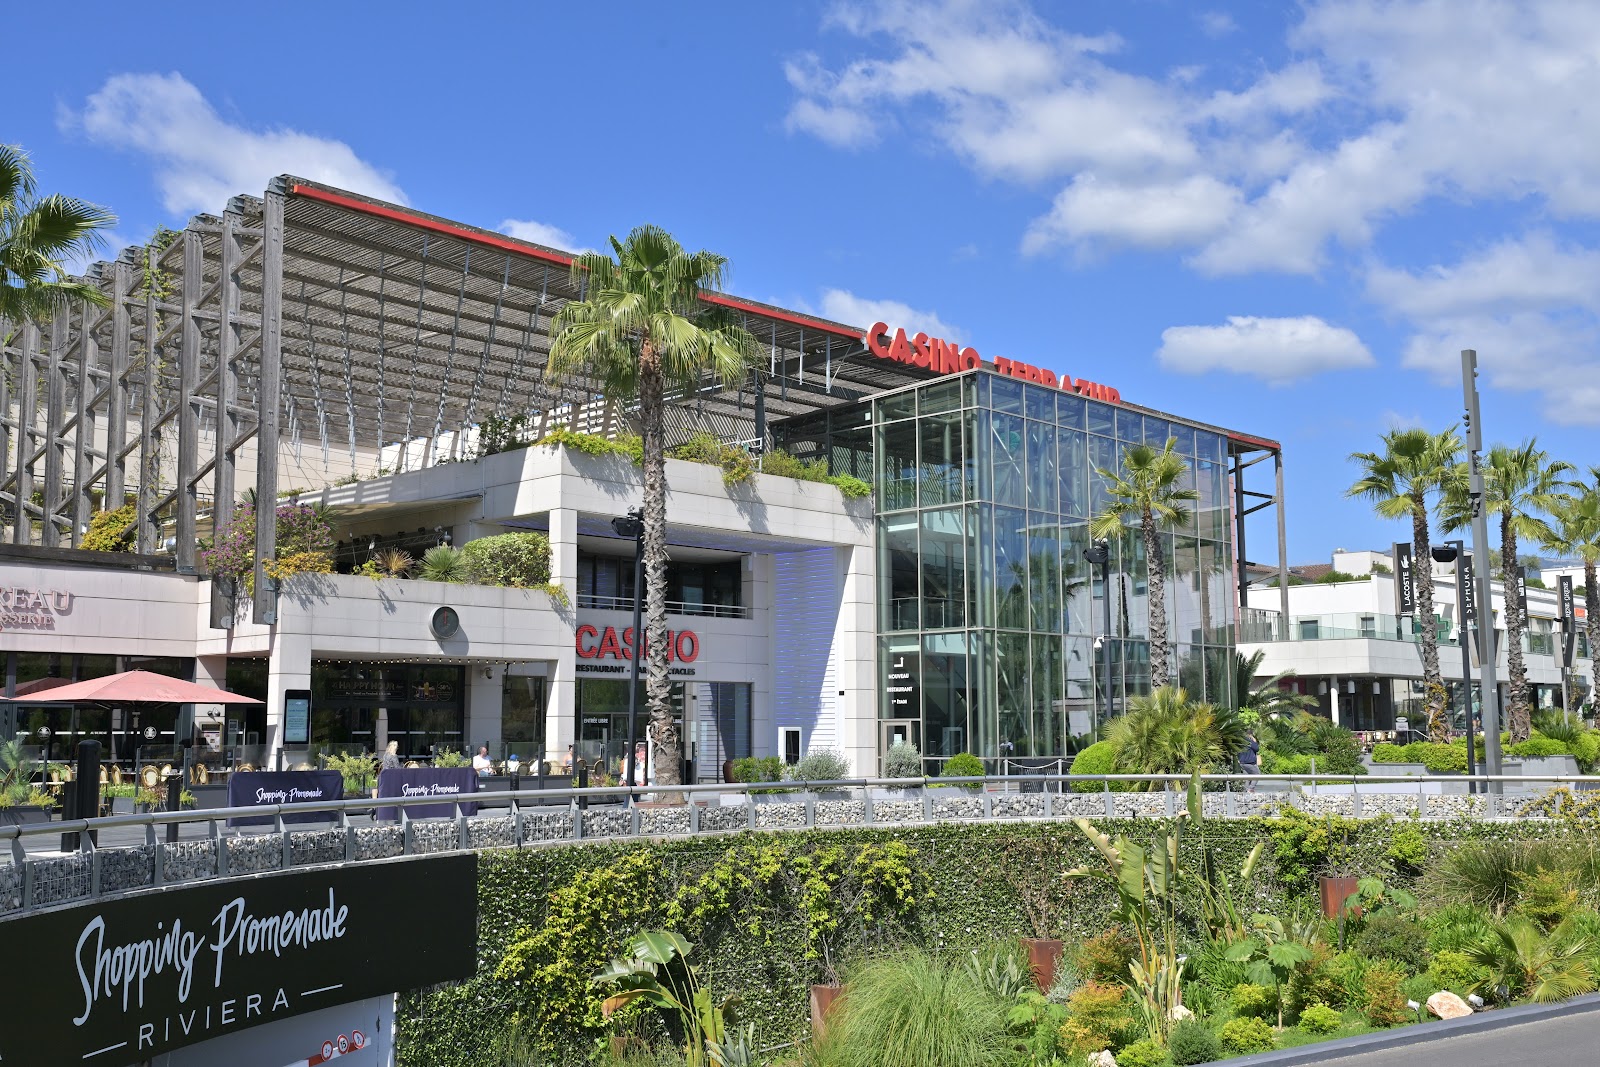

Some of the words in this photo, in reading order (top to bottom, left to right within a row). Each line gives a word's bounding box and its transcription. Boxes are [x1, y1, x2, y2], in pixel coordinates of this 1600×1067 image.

[867, 321, 981, 374] CASINO
[1403, 571, 1411, 606] LACOSTE
[256, 787, 289, 804] Shopping
[288, 787, 323, 802] Promenade
[401, 783, 430, 798] Shopping
[430, 783, 460, 796] Promenade
[72, 914, 206, 1027] Shopping
[210, 886, 349, 989] Promenade
[138, 988, 290, 1050] RIVIERA
